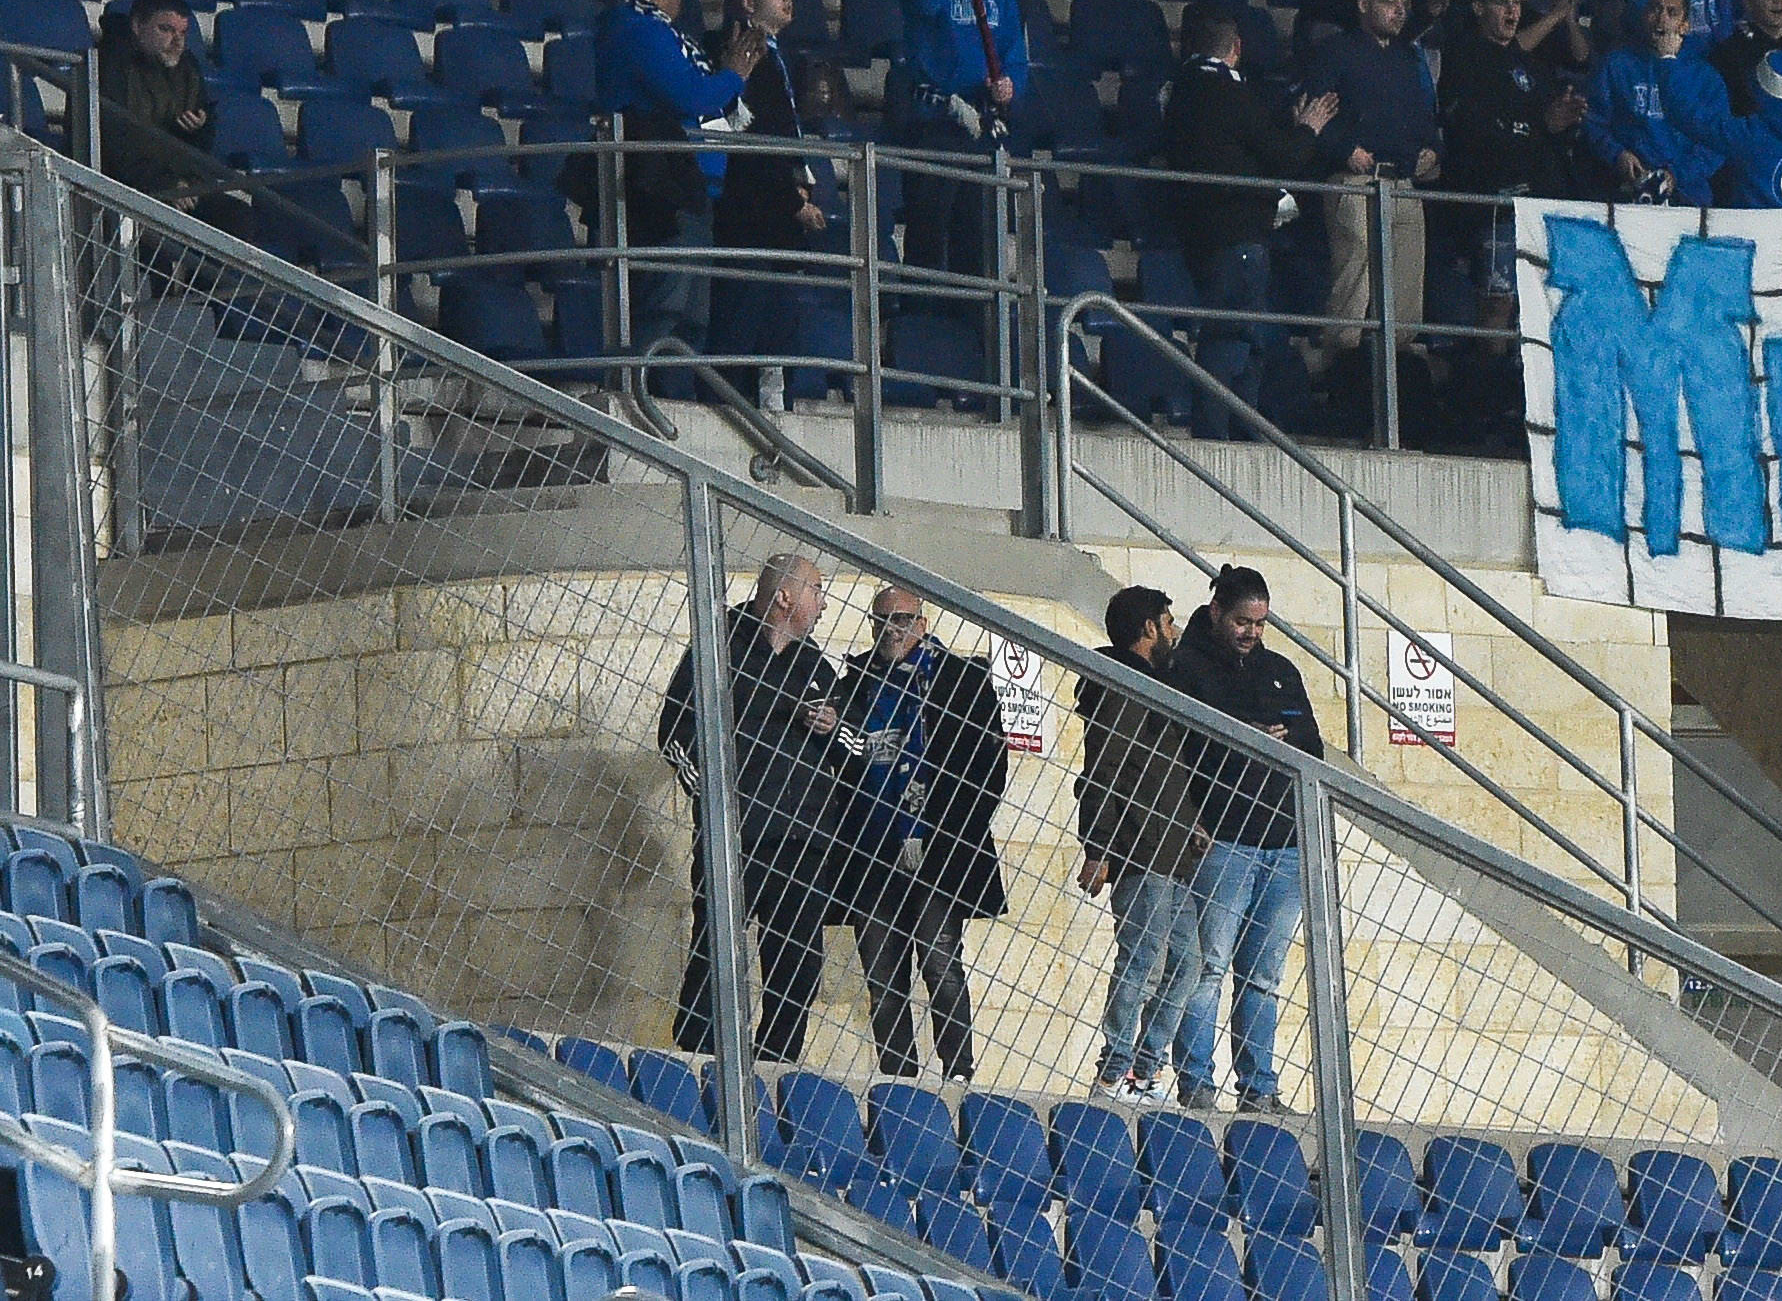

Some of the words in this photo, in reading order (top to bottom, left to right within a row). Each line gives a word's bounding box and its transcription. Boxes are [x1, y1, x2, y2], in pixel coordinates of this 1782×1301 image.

[1392, 685, 1421, 700] לעשן
[1424, 688, 1452, 700] אסור
[1408, 701, 1453, 713] SMOKING
[26, 1264, 44, 1280] 14
